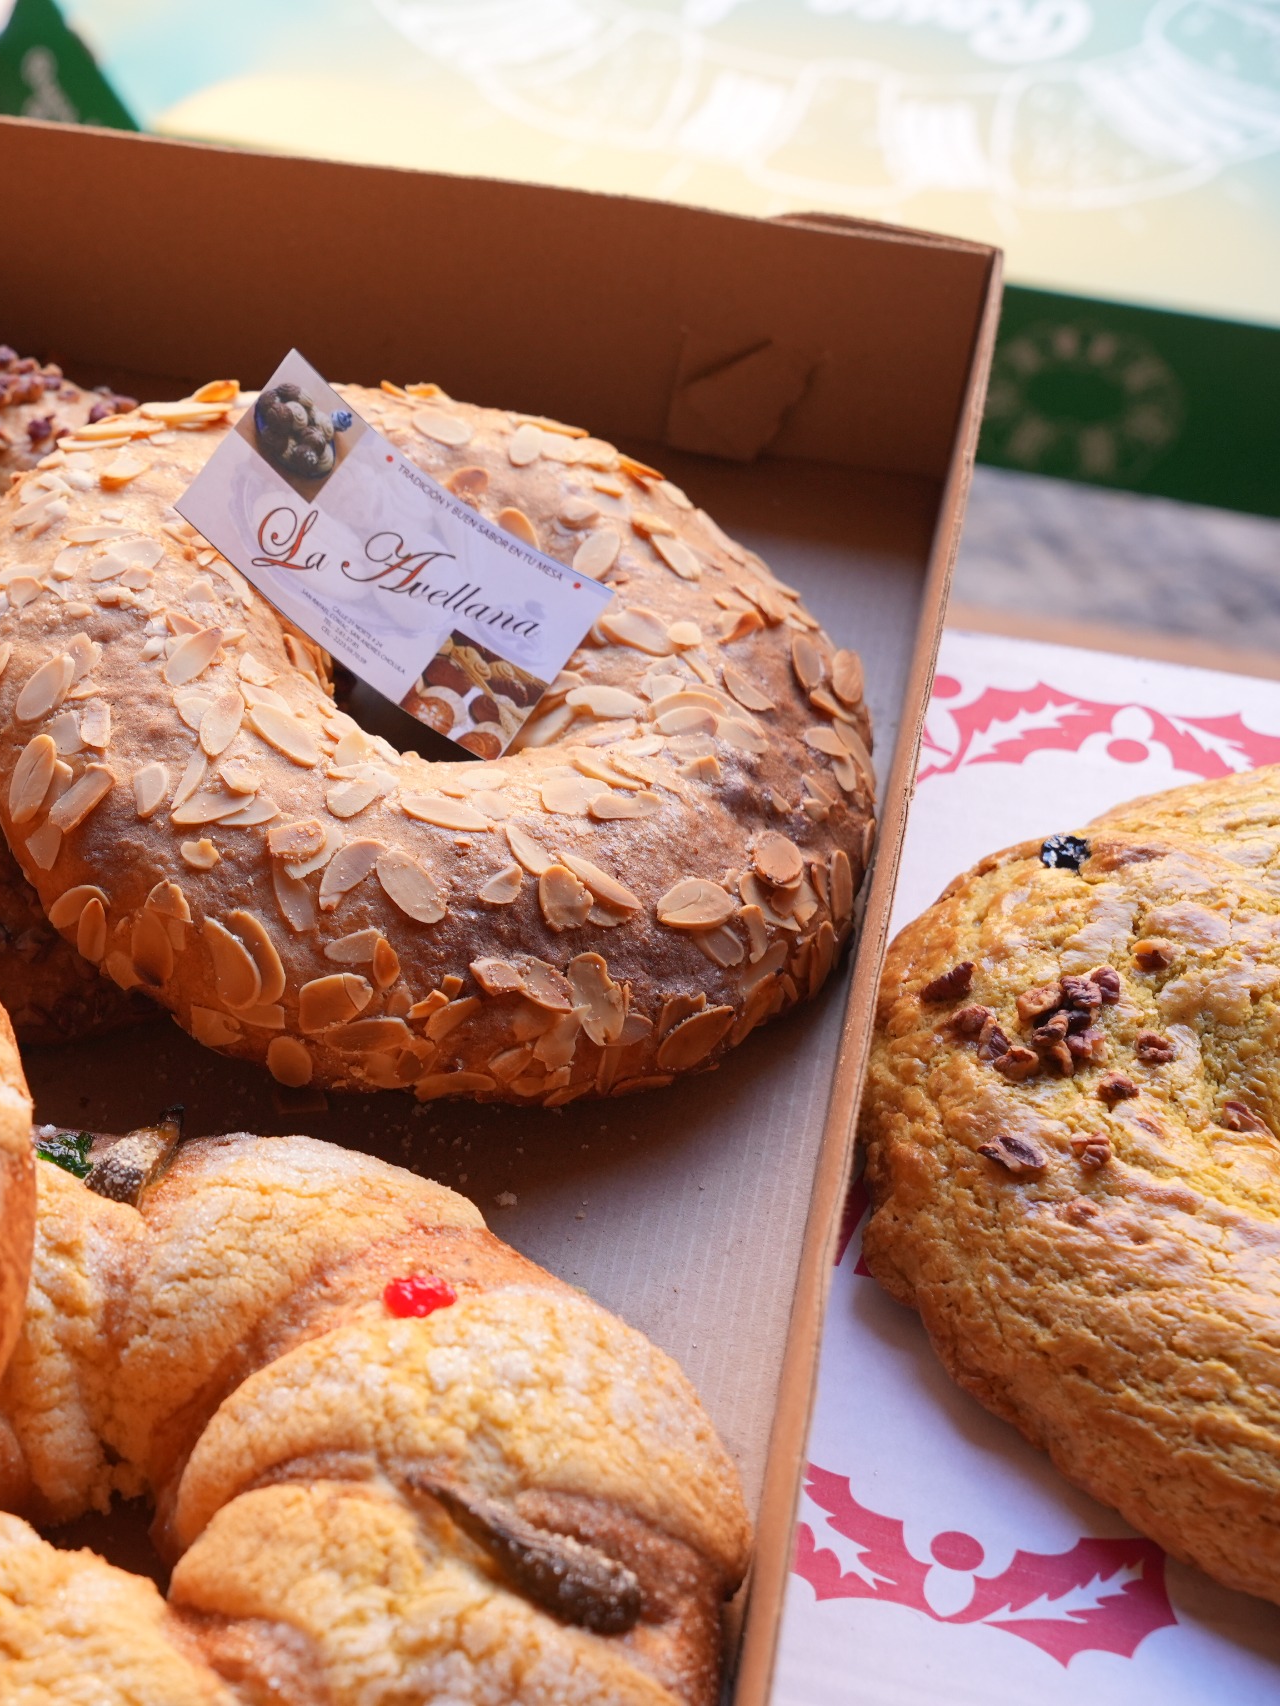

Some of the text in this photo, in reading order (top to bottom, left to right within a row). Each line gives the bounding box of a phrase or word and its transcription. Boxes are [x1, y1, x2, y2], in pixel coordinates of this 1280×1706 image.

[251, 507, 542, 639] La Avellana
[398, 463, 446, 506] TRADICIÓN
[451, 506, 477, 529] BUEN
[477, 523, 510, 548] SABOR
[508, 543, 522, 559] EN
[522, 552, 537, 566] TU
[536, 561, 564, 581] MESA
